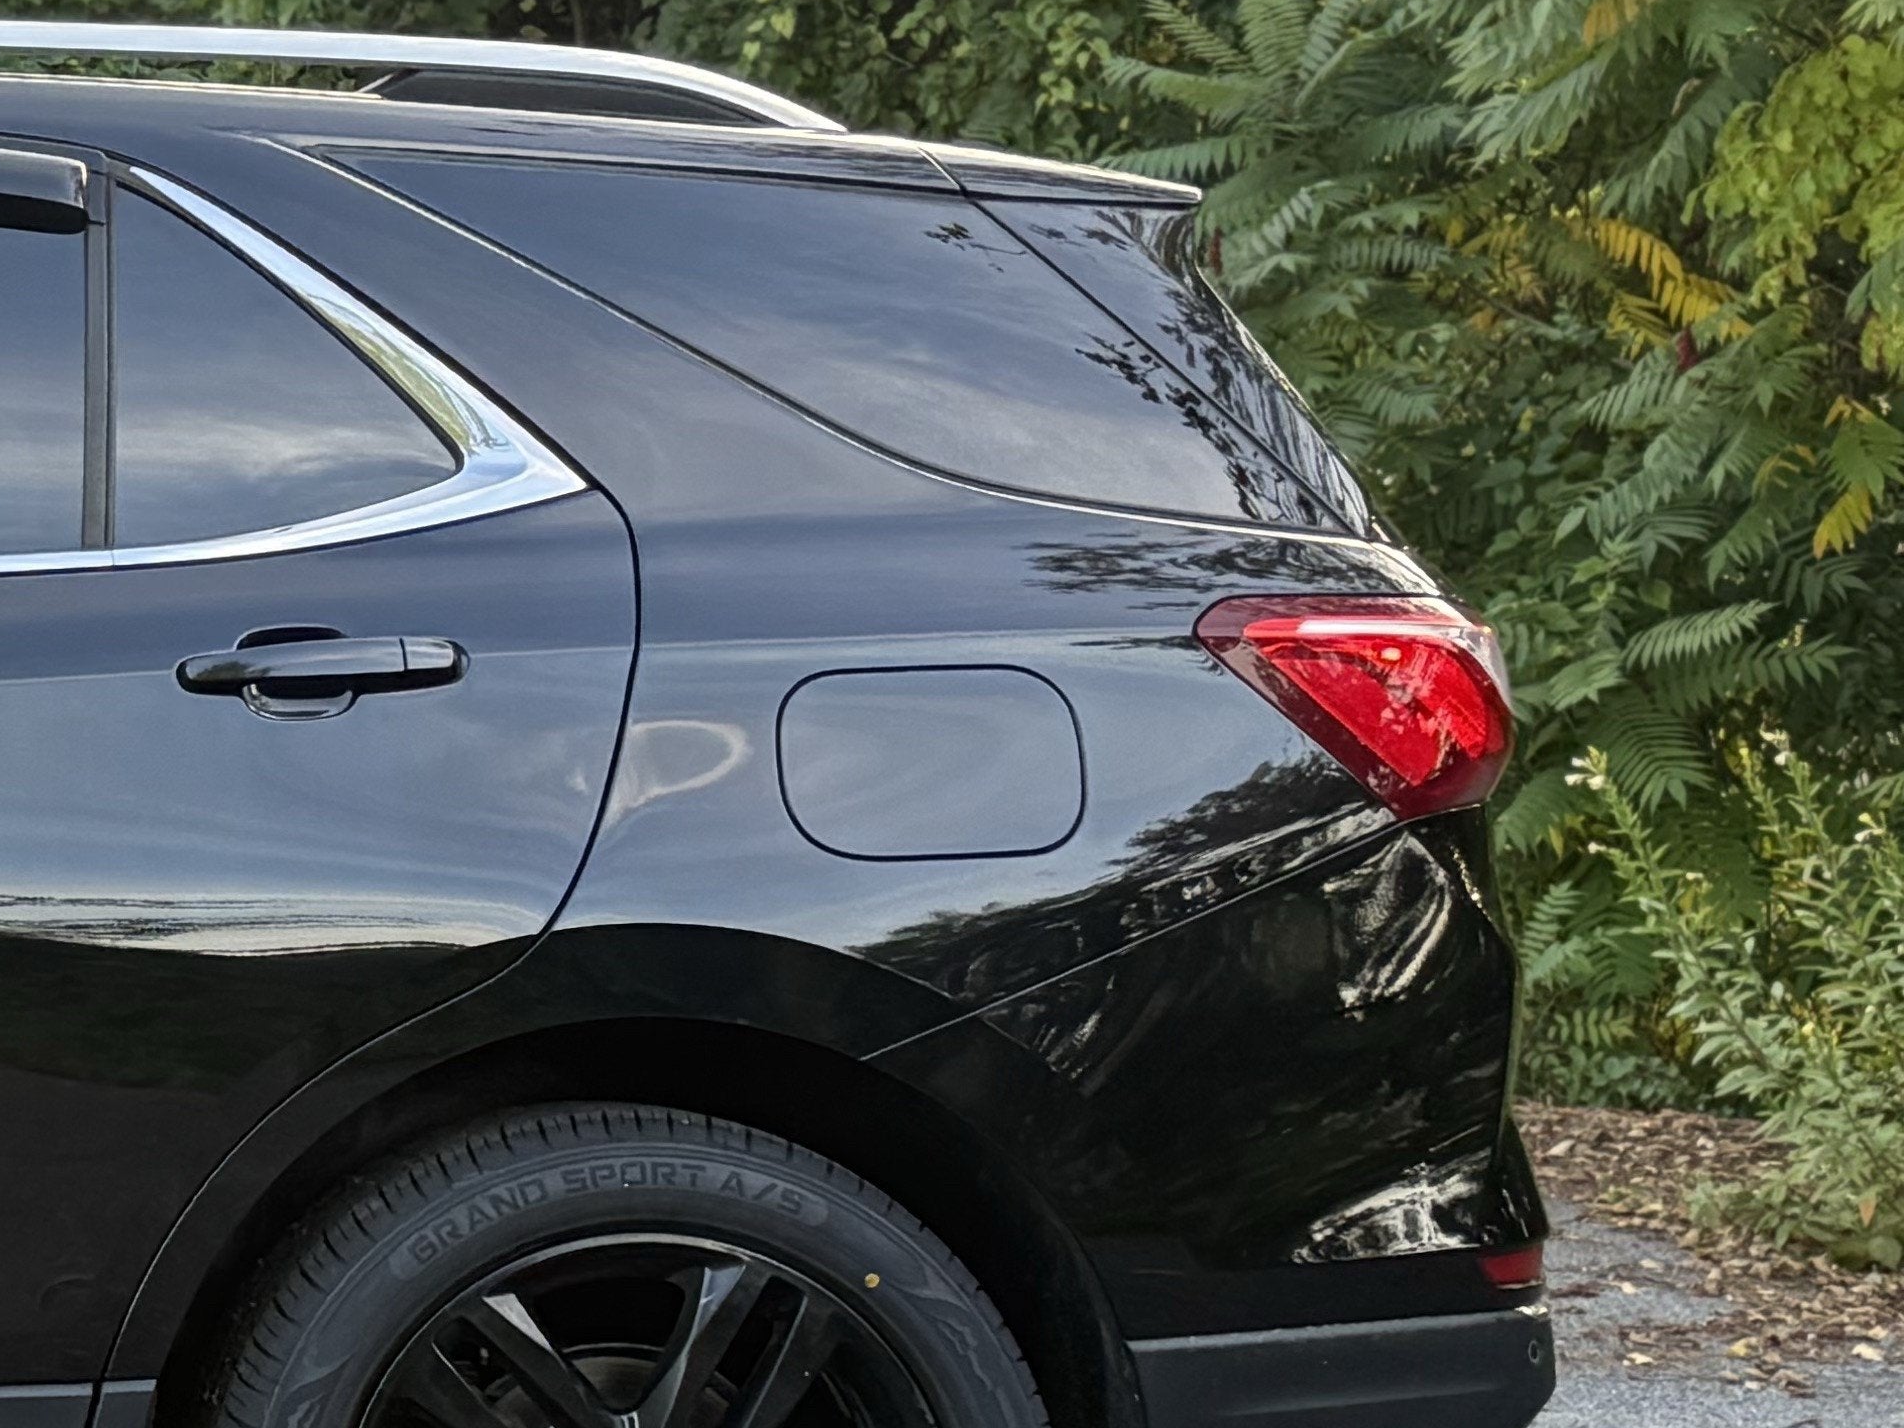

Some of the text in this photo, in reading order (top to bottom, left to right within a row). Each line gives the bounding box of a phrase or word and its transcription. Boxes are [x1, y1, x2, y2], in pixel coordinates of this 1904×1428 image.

[409, 1160, 804, 1264] GRAND SPORT A/S
